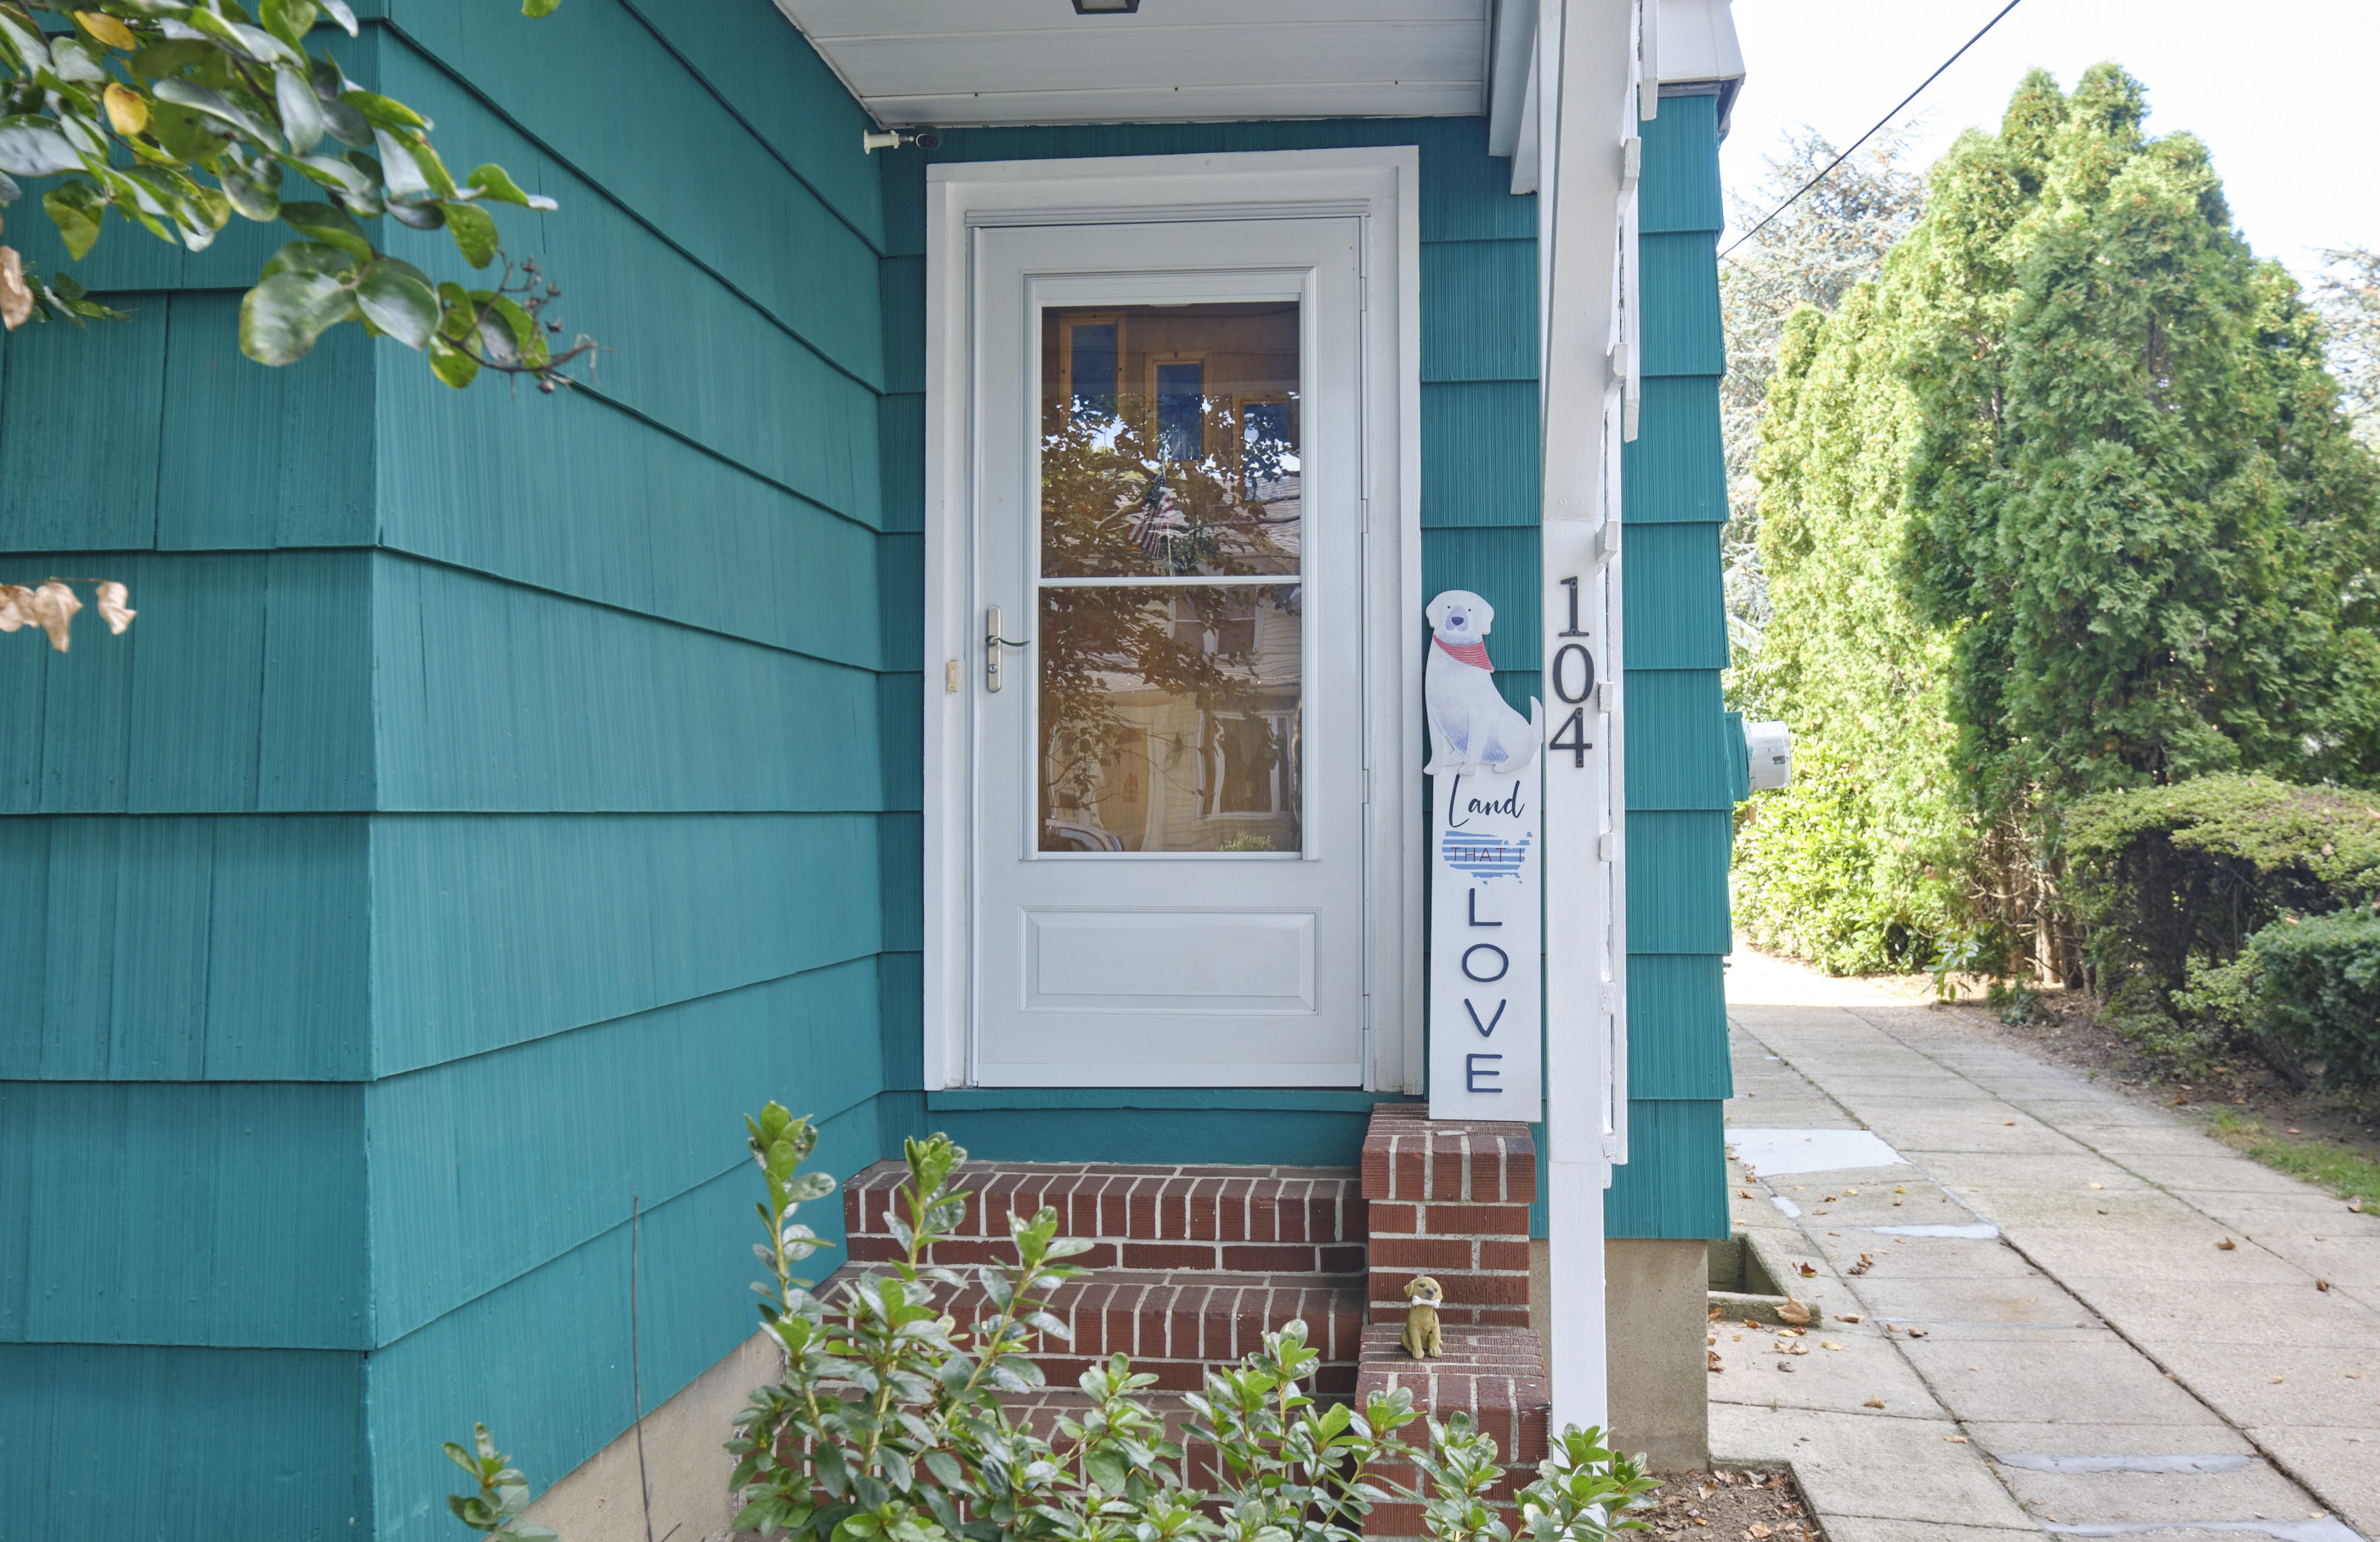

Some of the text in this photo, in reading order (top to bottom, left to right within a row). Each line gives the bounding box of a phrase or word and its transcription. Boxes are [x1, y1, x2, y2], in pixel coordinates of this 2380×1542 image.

[1550, 575, 1595, 768] 104
[1448, 774, 1525, 828] Land
[1450, 847, 1506, 862] THAT
[1461, 887, 1510, 1093] LOVE
